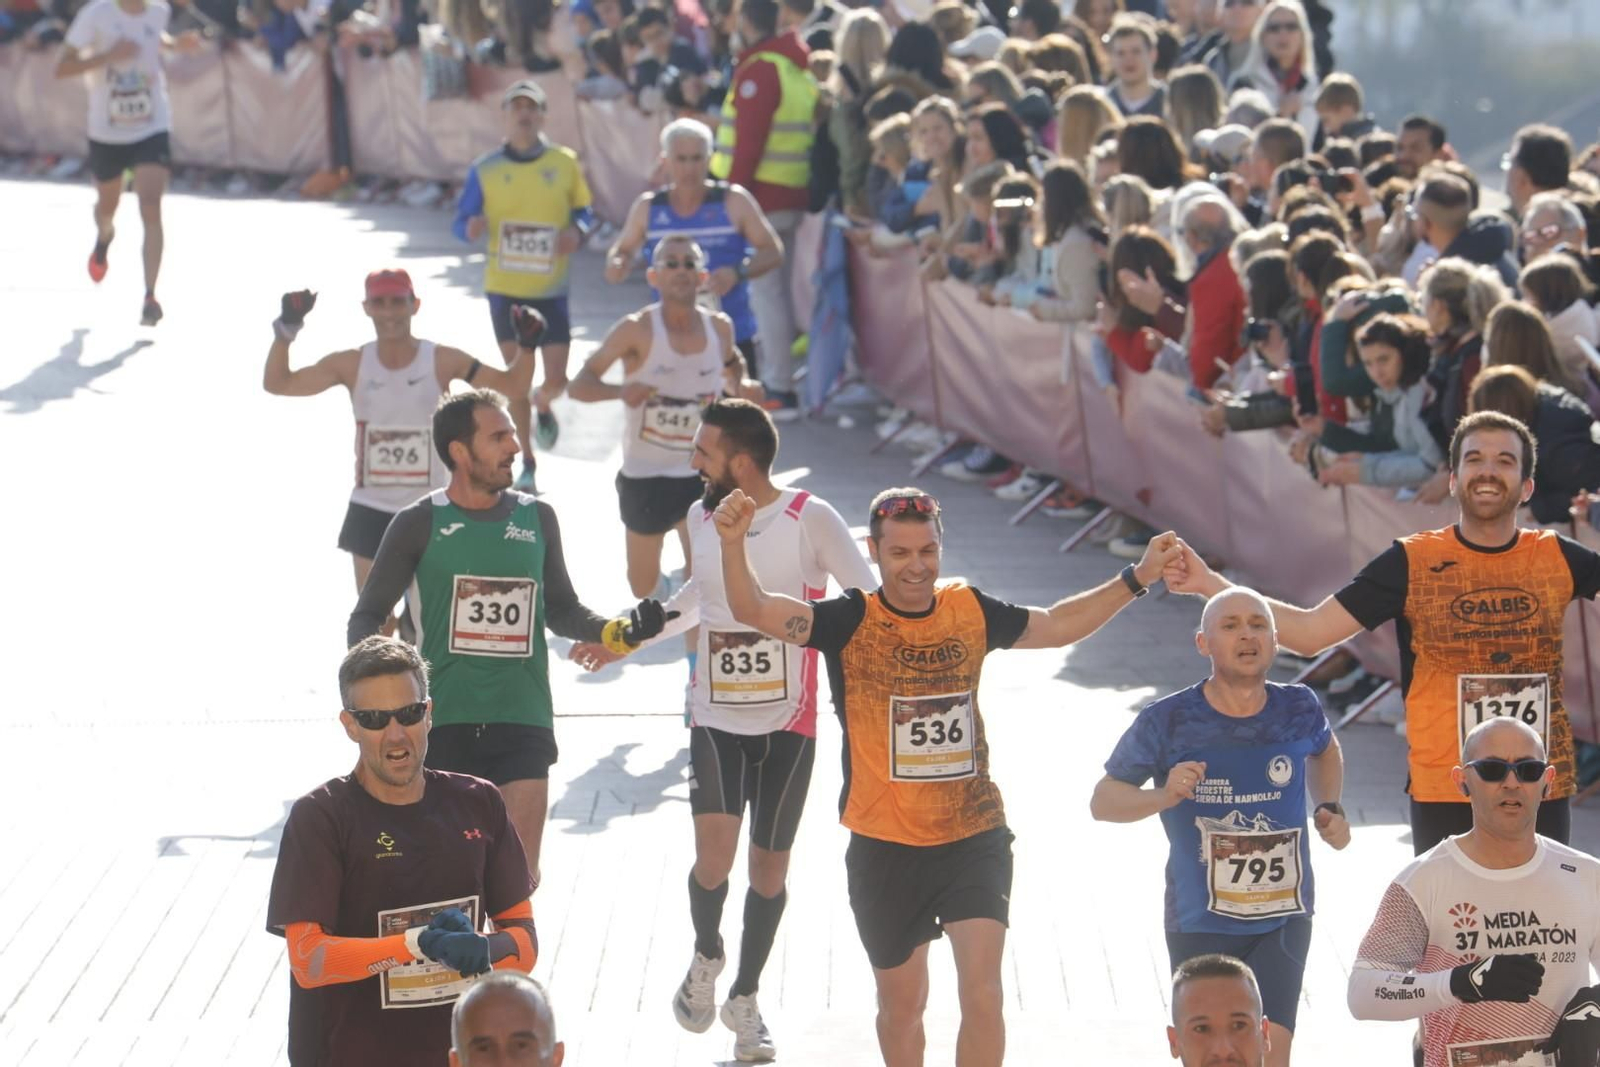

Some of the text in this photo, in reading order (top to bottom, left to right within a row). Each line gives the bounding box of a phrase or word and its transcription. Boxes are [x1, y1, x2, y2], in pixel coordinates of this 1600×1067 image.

[657, 411, 690, 427] 541
[378, 447, 419, 464] 296
[468, 601, 520, 625] 330
[1460, 596, 1531, 615] GALBIS
[720, 651, 771, 674] 835
[901, 643, 962, 664] GALBIS
[1473, 700, 1538, 725] 1376
[910, 718, 963, 746] 536
[1195, 786, 1233, 795] PEDESTRE
[1195, 791, 1281, 804] SIERRA DE MARMOLEJO
[1228, 857, 1285, 884] 795
[1484, 910, 1540, 930] MEDIA
[1455, 923, 1576, 950] 37 MARATÓN
[1551, 951, 1576, 963] 2023
[1374, 987, 1425, 1000] #Sevilla10
